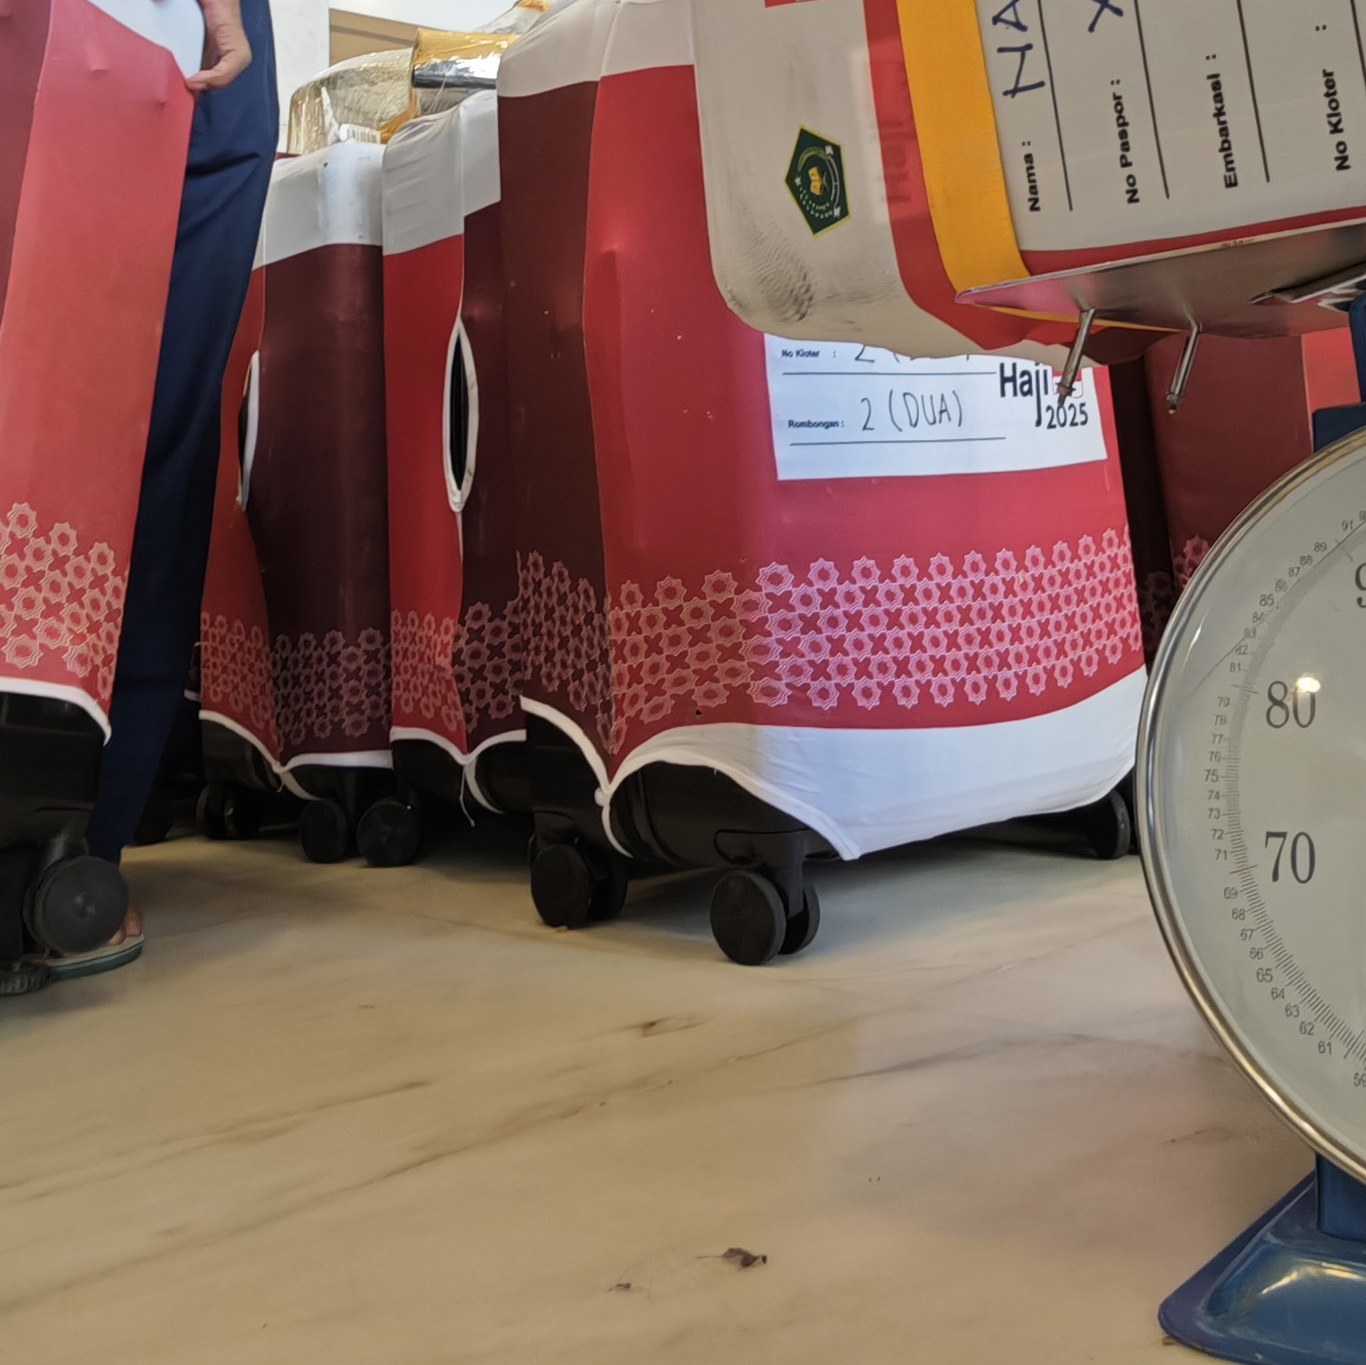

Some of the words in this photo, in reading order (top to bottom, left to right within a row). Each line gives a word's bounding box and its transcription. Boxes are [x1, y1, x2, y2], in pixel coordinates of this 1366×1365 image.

[1321, 69, 1346, 135] Kloter
[1334, 142, 1352, 171] No
[1125, 173, 1141, 204] No
[861, 397, 875, 431] 2
[888, 389, 963, 433] (DUA)
[1045, 402, 1089, 431] 2025
[1266, 680, 1316, 729] 80
[1204, 769, 1219, 783] 75
[1207, 789, 1221, 801] 74
[1208, 808, 1221, 820] 73
[1211, 829, 1225, 841] 72
[1215, 849, 1228, 861] 71
[1264, 830, 1316, 884] 70
[1224, 886, 1238, 899] 69
[1231, 907, 1246, 921] 68
[1240, 929, 1255, 940] 67
[1256, 968, 1273, 983] 65
[1271, 987, 1285, 1000] 64
[1285, 1003, 1300, 1018] 63
[1299, 1021, 1315, 1036] 62
[1318, 1040, 1332, 1056] 61
